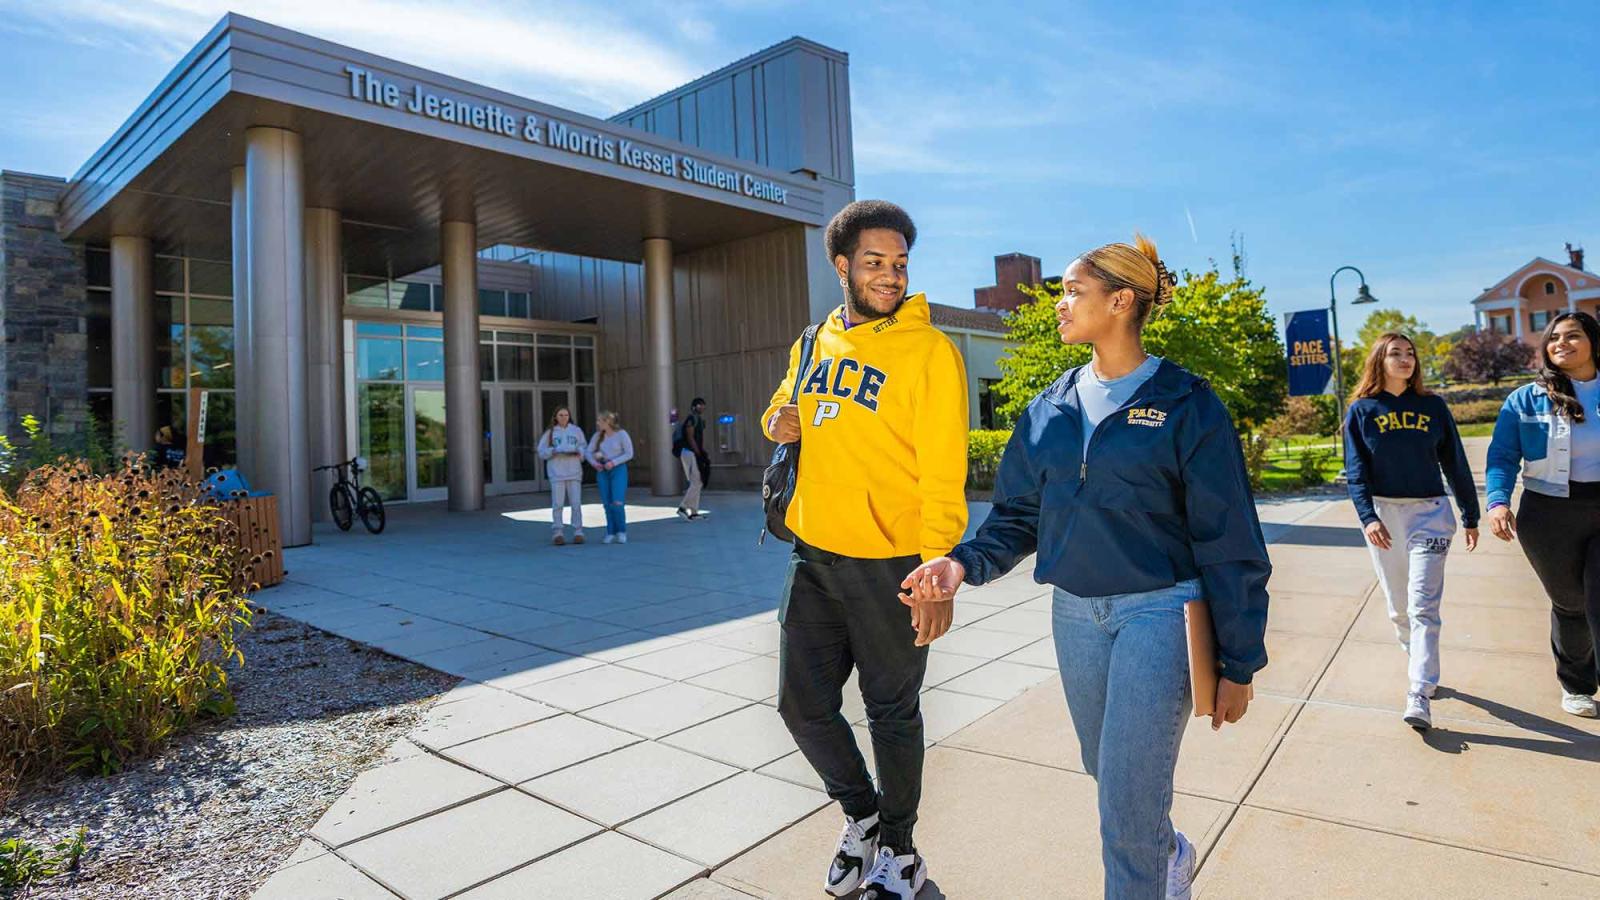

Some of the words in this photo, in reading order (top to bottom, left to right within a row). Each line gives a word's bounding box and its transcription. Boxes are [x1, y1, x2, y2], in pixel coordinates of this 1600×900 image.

[345, 65, 400, 107] The
[407, 84, 517, 137] Jeanette
[523, 114, 540, 143] &
[546, 119, 615, 162] Morris
[618, 137, 677, 177] Kessel
[681, 156, 741, 193] Student
[743, 173, 789, 204] Center
[1294, 340, 1324, 355] PACE
[1290, 353, 1329, 366] SETTERS
[802, 357, 888, 413] ACE
[813, 400, 840, 427] P
[1127, 408, 1167, 421] PACE
[1374, 411, 1431, 433] PACE
